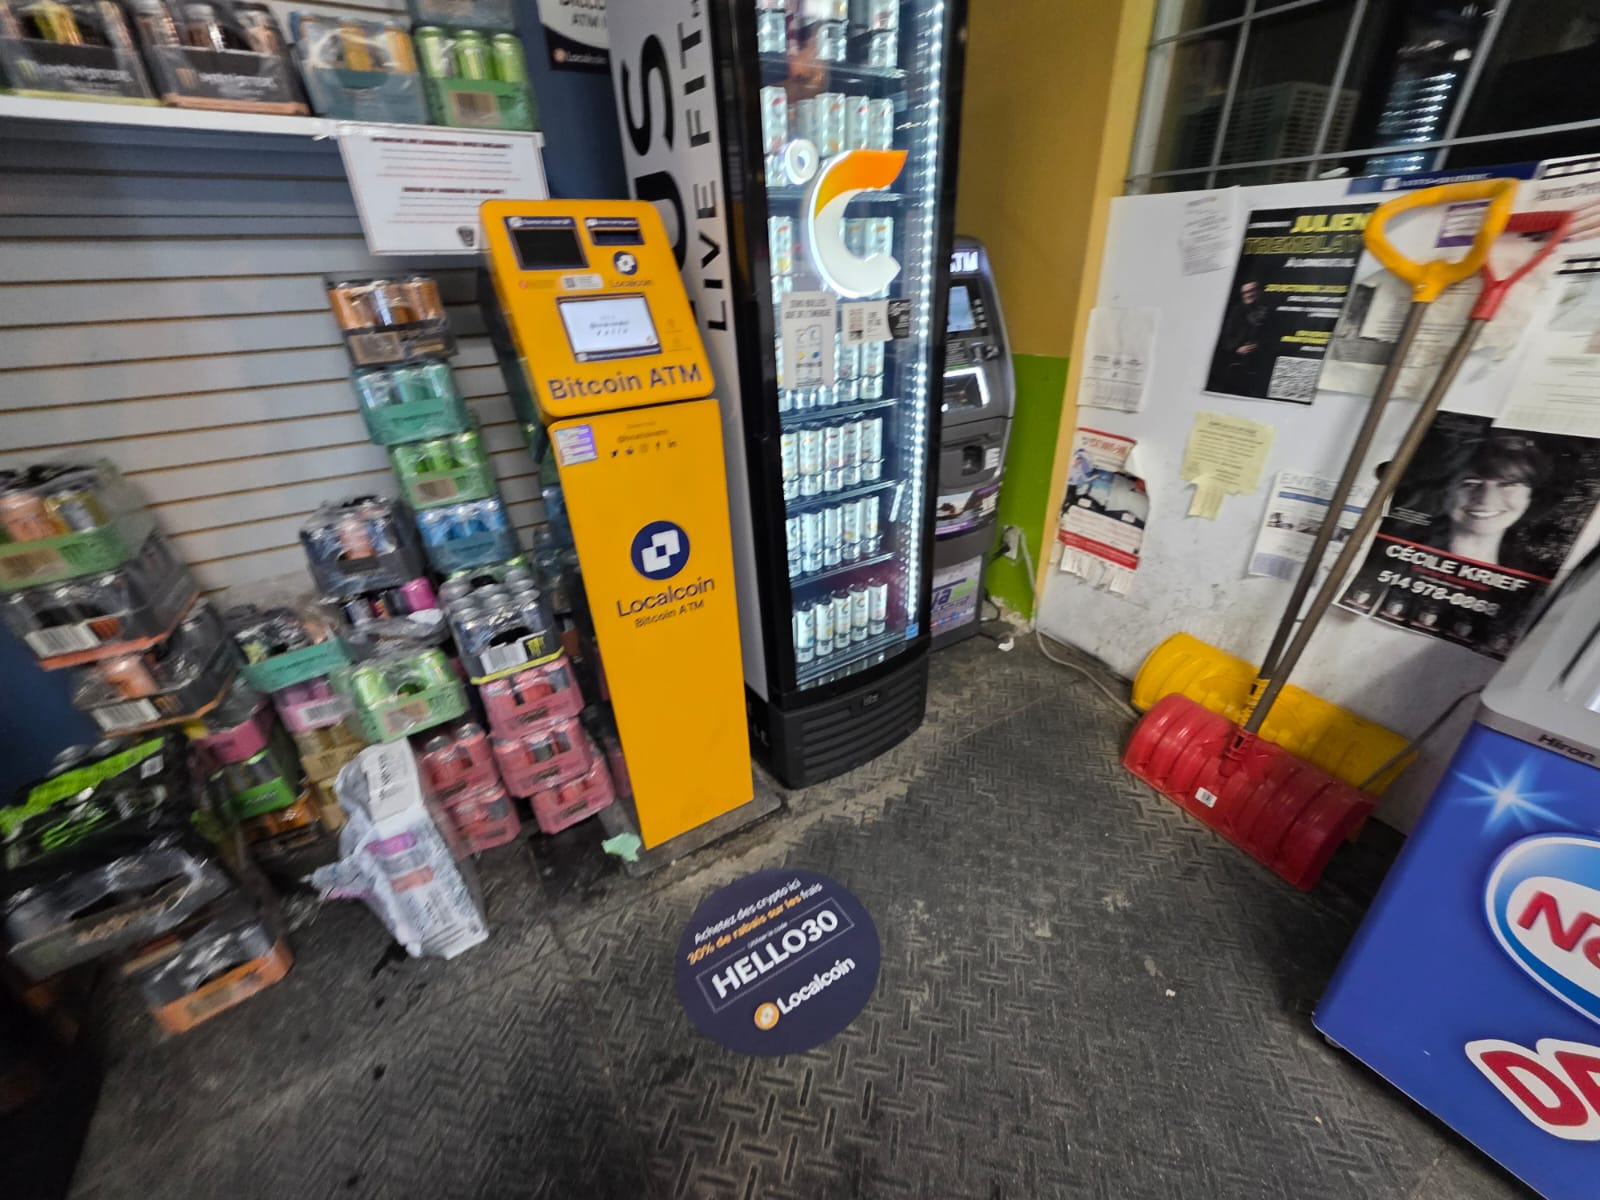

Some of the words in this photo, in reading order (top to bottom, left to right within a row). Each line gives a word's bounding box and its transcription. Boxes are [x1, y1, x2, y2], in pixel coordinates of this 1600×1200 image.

[677, 22, 711, 148] FIT
[693, 180, 728, 331] LIVE
[548, 372, 642, 401] Bitcoin
[650, 363, 703, 388] ATM
[1377, 570, 1411, 589] 514
[1385, 545, 1458, 574] CÉCILE
[1458, 565, 1530, 592] KRIEF
[617, 576, 715, 617] Localcoin
[635, 609, 676, 628] Bitcoin
[679, 600, 704, 615] ATM
[712, 910, 838, 999] HELLO30
[776, 957, 856, 1015] Localcoin
